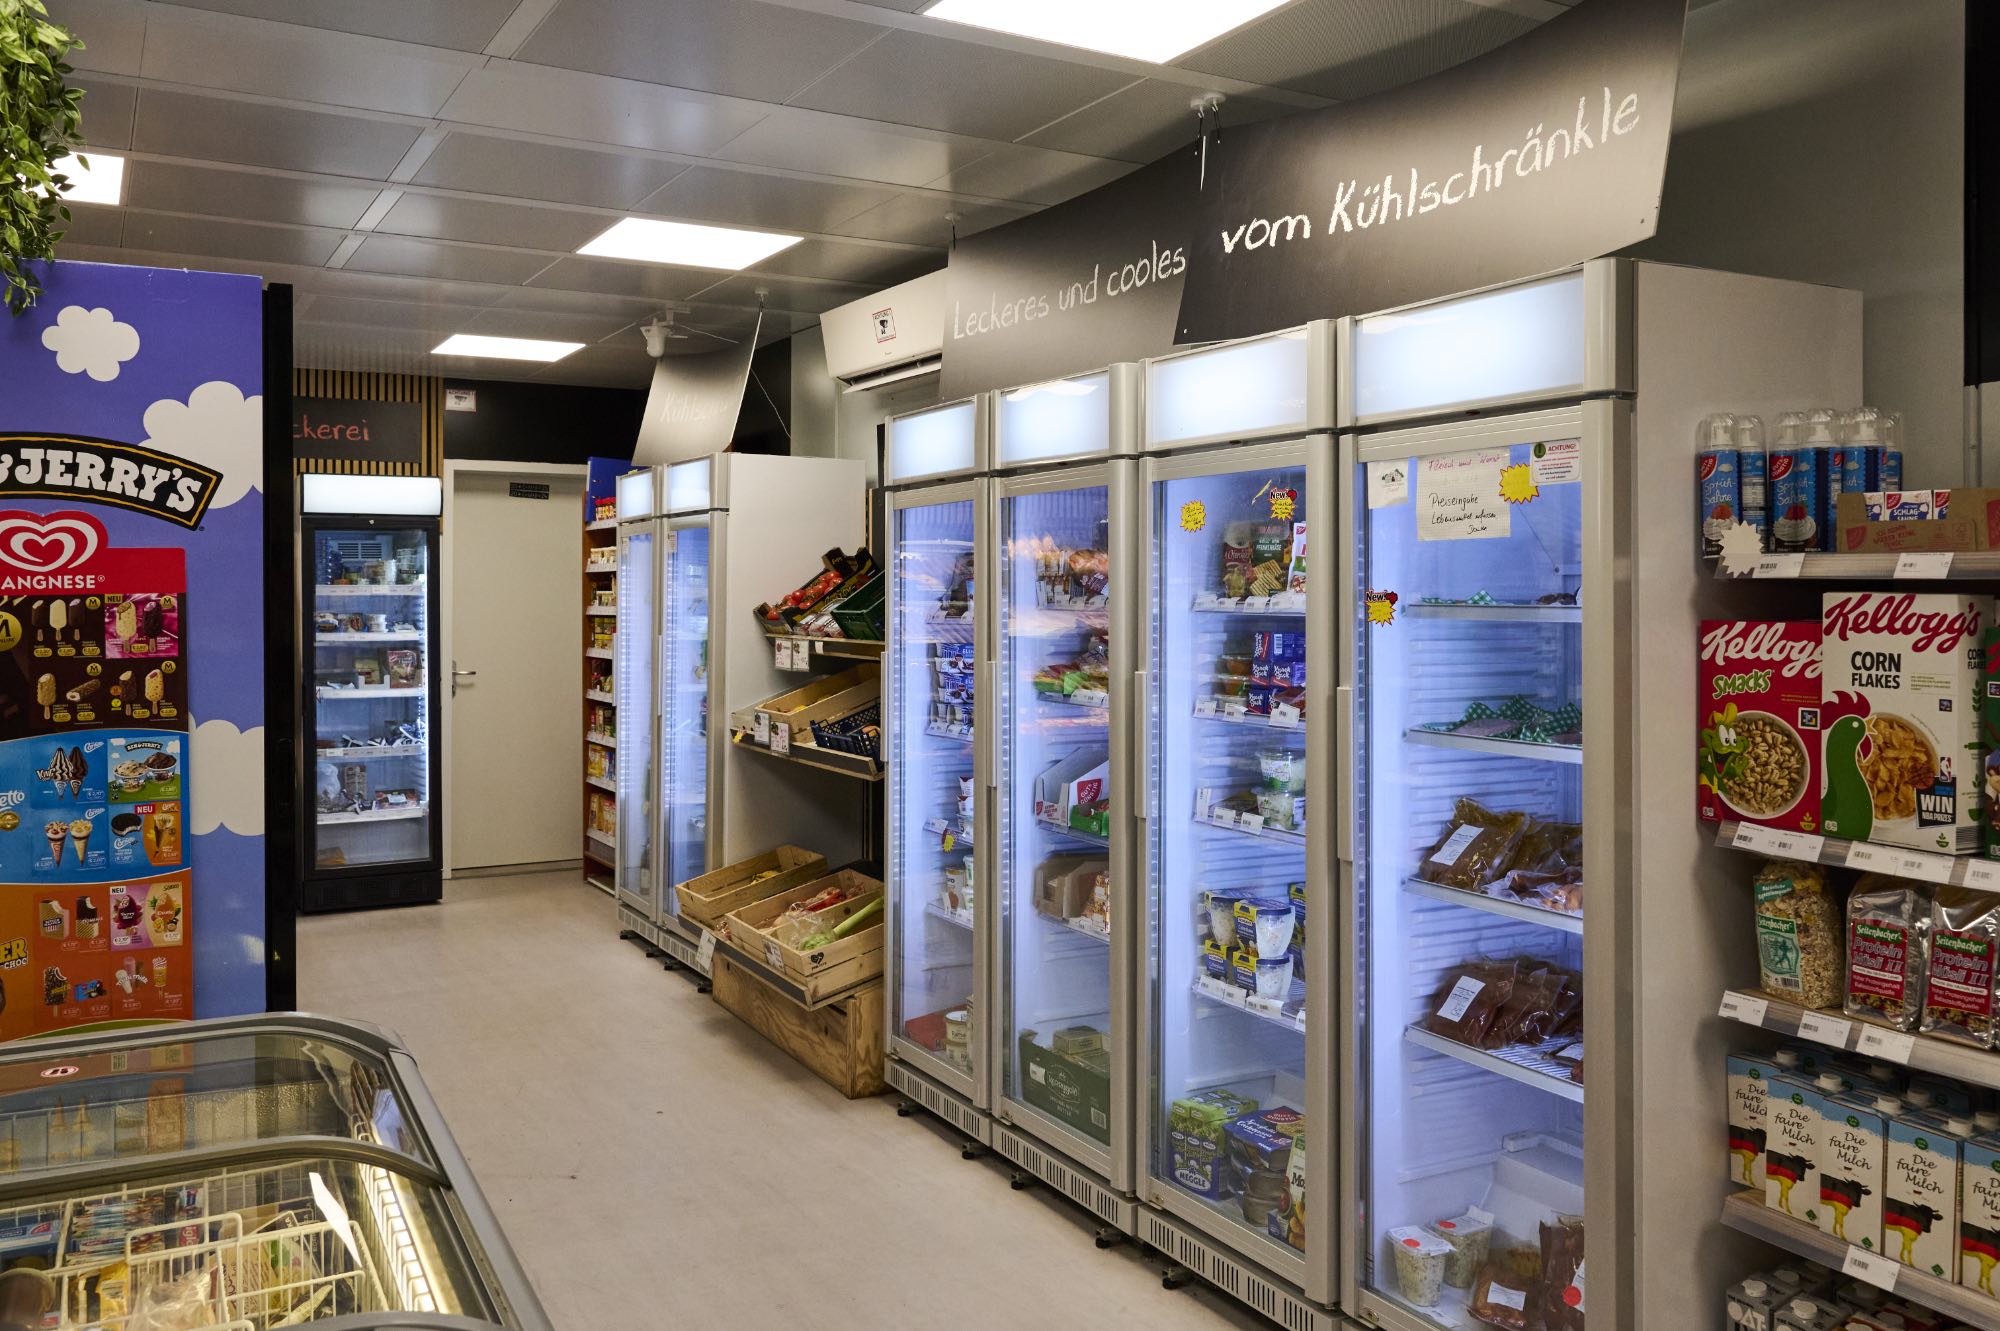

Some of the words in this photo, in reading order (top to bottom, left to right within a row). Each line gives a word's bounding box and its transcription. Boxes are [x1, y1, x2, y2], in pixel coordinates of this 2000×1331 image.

[1221, 215, 1311, 255] vom
[1328, 86, 1641, 235] Kühlschränkle
[953, 283, 1050, 340] Leckeres
[1057, 265, 1099, 308] und
[1107, 241, 1187, 297] cooles
[1548, 443, 1577, 451] ACHTUNG!
[14, 448, 202, 513] JERRY'S
[1429, 493, 1478, 511] Preiseingabe
[1704, 492, 1733, 505] Sahne
[1, 575, 96, 589] ANGNESE
[1823, 593, 1980, 654] Kellogg's
[1851, 651, 1901, 673] CORN
[1851, 673, 1901, 689] FLAKES
[137, 805, 153, 813] NEU
[1920, 794, 1953, 814] WIN
[1758, 916, 1790, 932] Seitenbacher
[1856, 924, 1899, 942] Seitenbacher
[1853, 937, 1903, 959] Protein
[1936, 935, 1984, 954] Seitenbacher
[1853, 951, 1884, 970] Müsli
[1932, 947, 1989, 971] Protein
[1931, 963, 1966, 983] Müsli
[1735, 1089, 1763, 1104] faire
[1748, 1084, 1767, 1096] Die
[1774, 1113, 1805, 1130] faire
[1790, 1108, 1810, 1122] Die
[1782, 1126, 1816, 1145] Milch
[1845, 1132, 1867, 1146] Die
[1829, 1136, 1861, 1154] faire
[1836, 1149, 1872, 1170] Milch
[1896, 1158, 1931, 1177] faire
[1912, 1154, 1938, 1169] Die
[1179, 1171, 1206, 1188] MEGGLE
[1905, 1172, 1944, 1195] Milch
